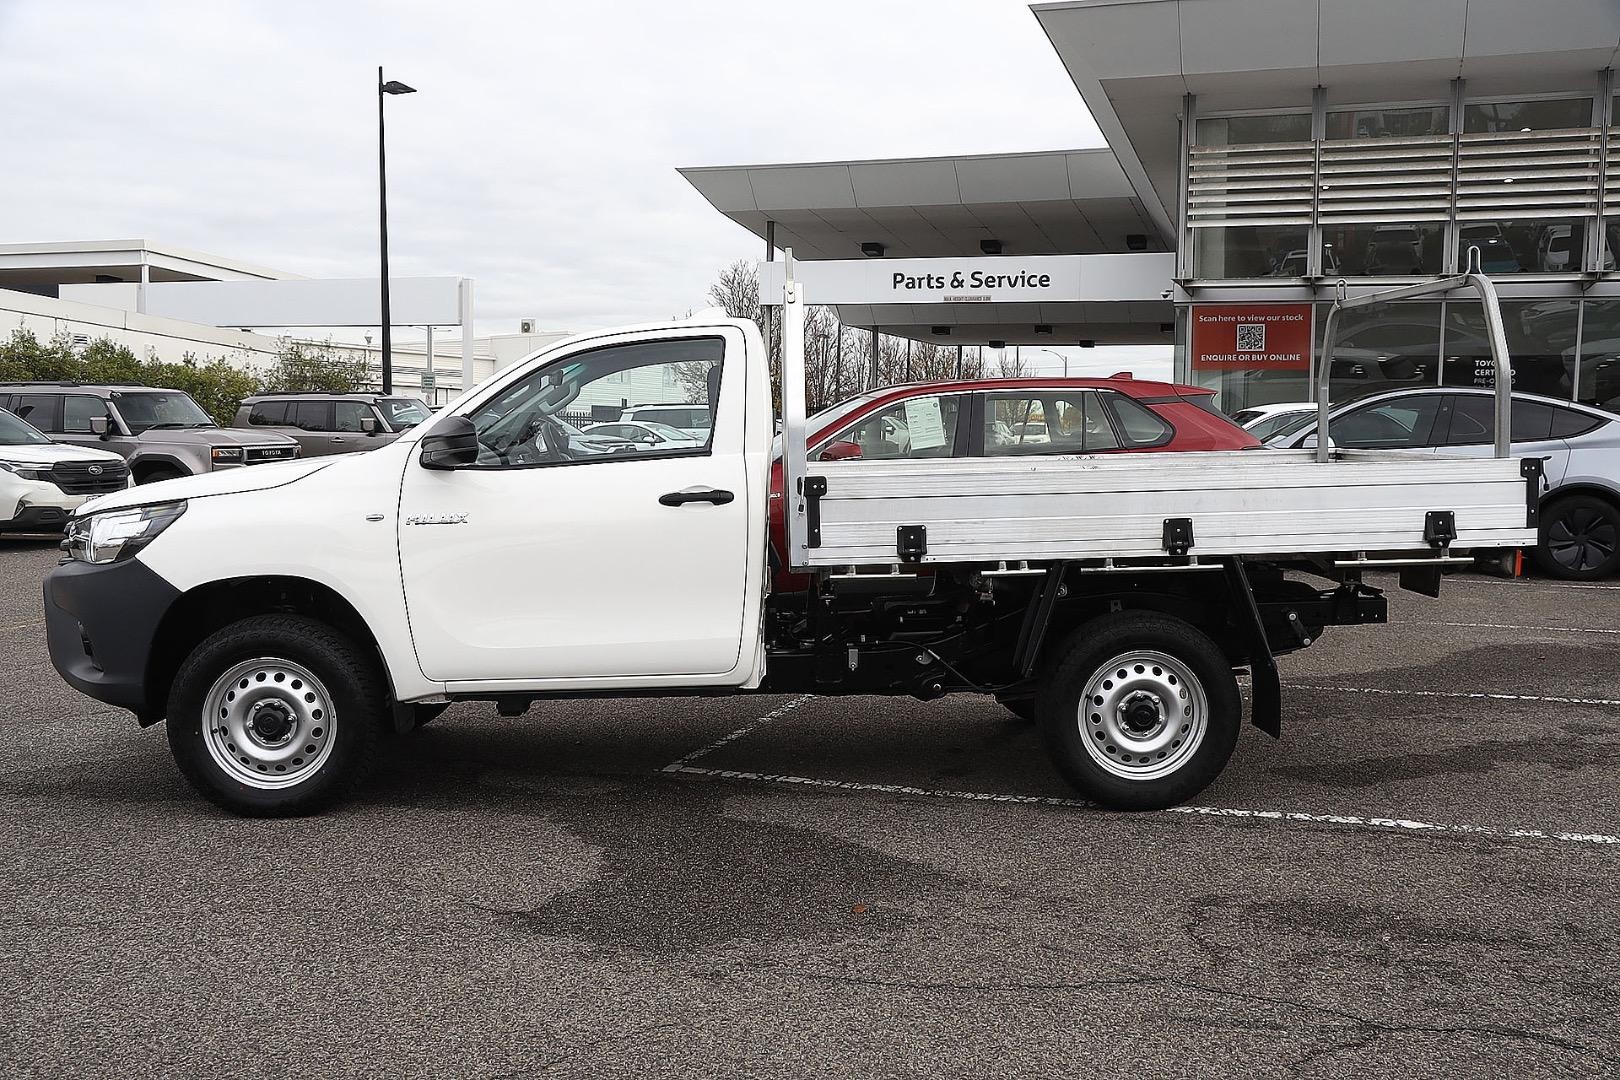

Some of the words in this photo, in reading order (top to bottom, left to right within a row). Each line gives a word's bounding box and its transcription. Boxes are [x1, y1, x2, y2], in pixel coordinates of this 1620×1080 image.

[892, 272, 945, 290] Parts
[949, 271, 965, 289] &
[969, 270, 1051, 289] Service
[1218, 314, 1236, 322] here
[1281, 313, 1304, 321] stock
[1201, 354, 1237, 362] ENQUIRE
[1269, 353, 1301, 361] ONLINE
